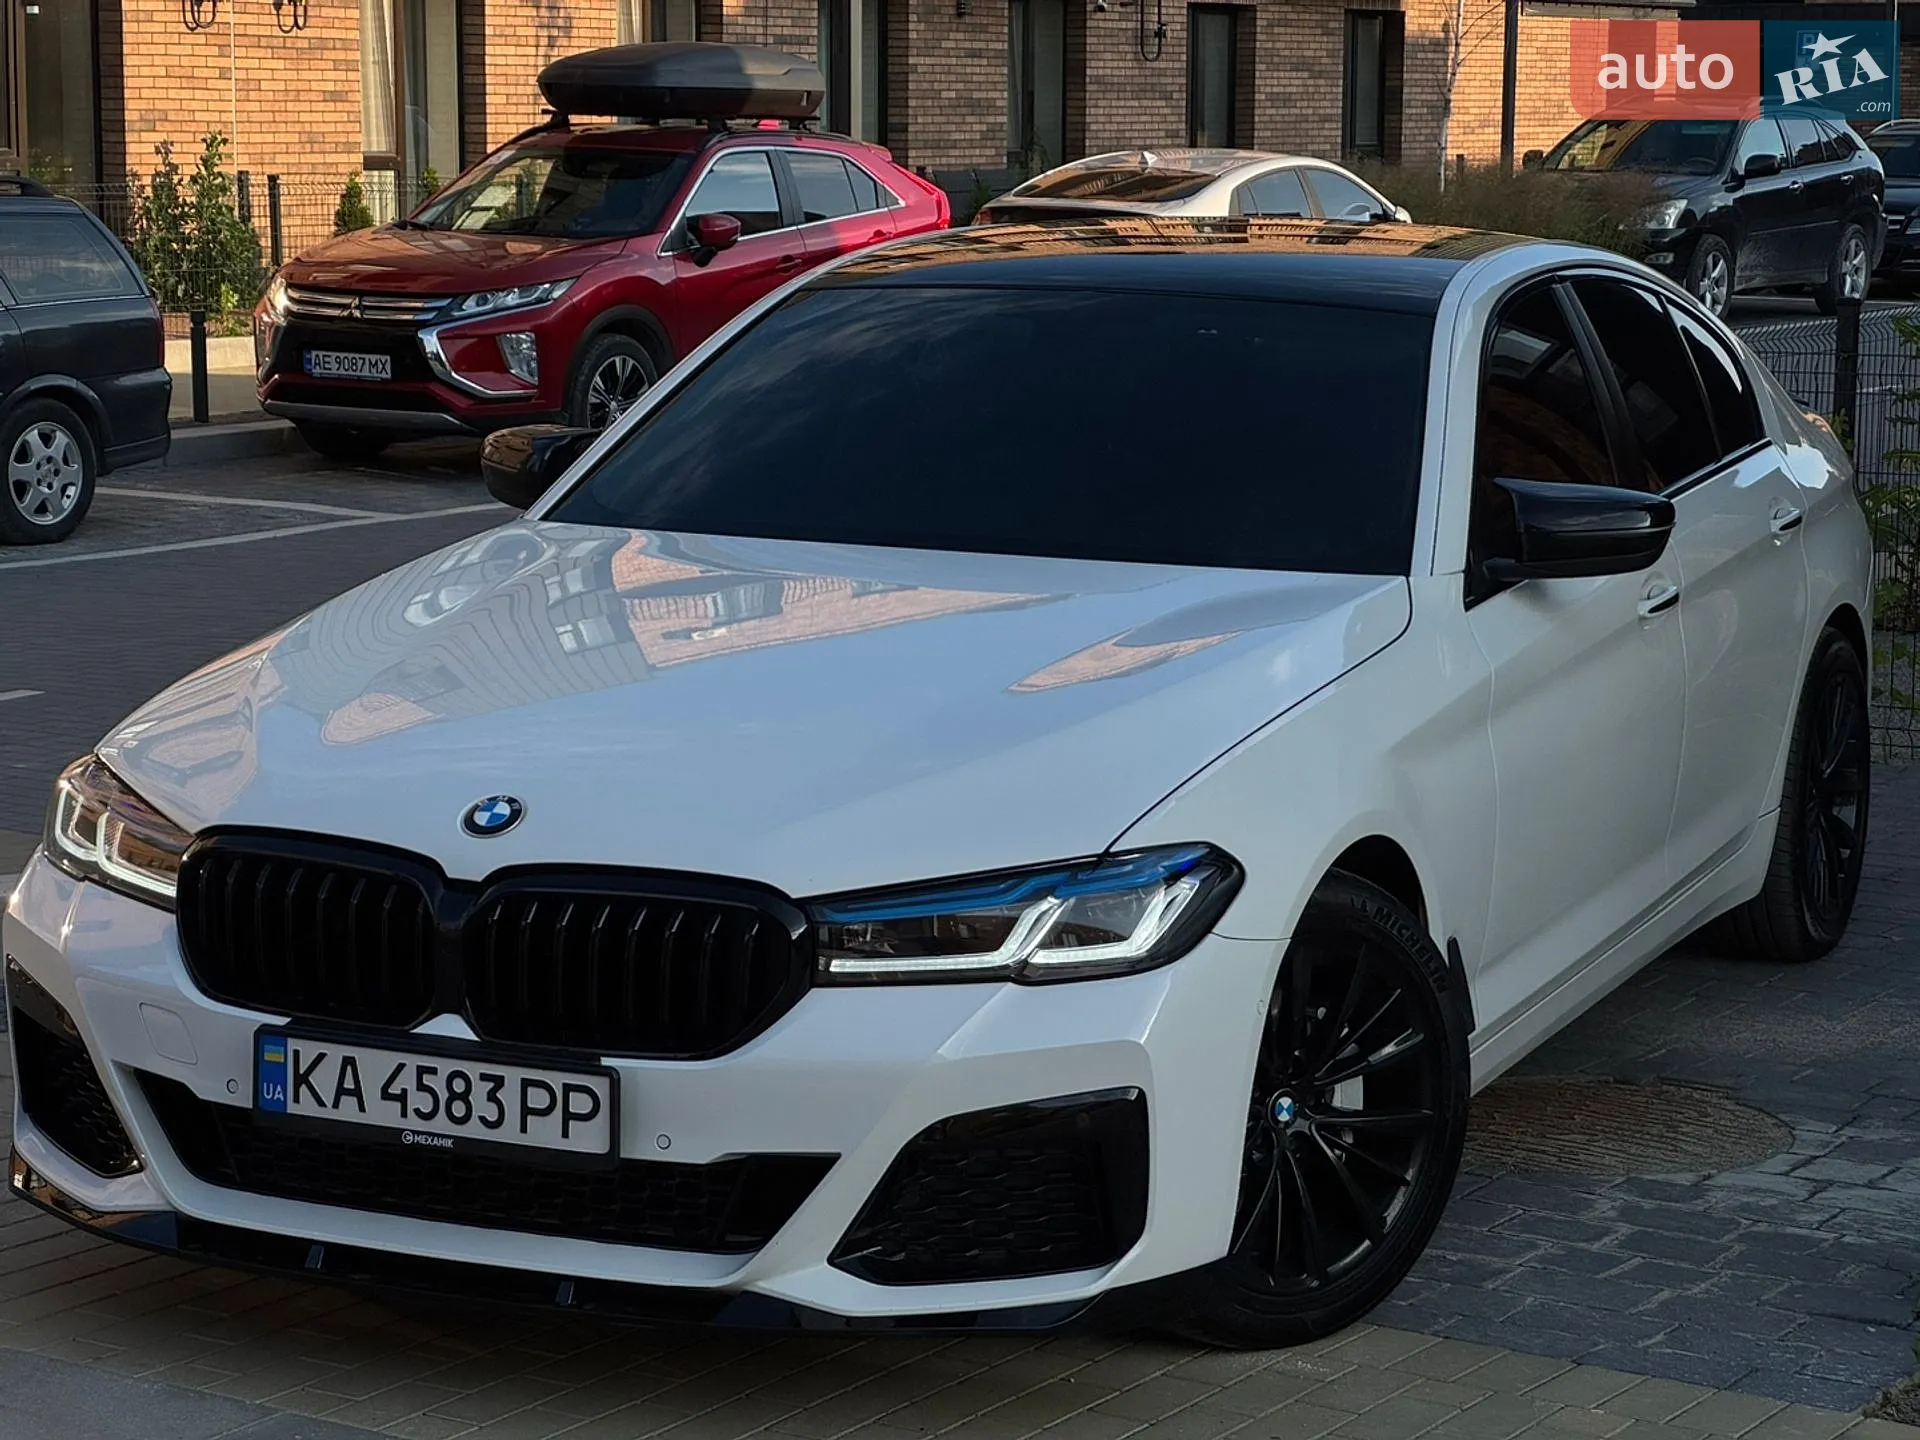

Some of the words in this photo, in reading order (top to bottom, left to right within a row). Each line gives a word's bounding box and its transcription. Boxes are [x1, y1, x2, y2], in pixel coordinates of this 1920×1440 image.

[313, 353, 332, 371] AE
[335, 355, 366, 374] 9087
[368, 358, 389, 375] MX
[1372, 905, 1449, 995] MICHELIN
[263, 1082, 285, 1101] UA
[291, 1048, 367, 1114] KA
[380, 1061, 506, 1131] 4583
[519, 1077, 602, 1140] PP
